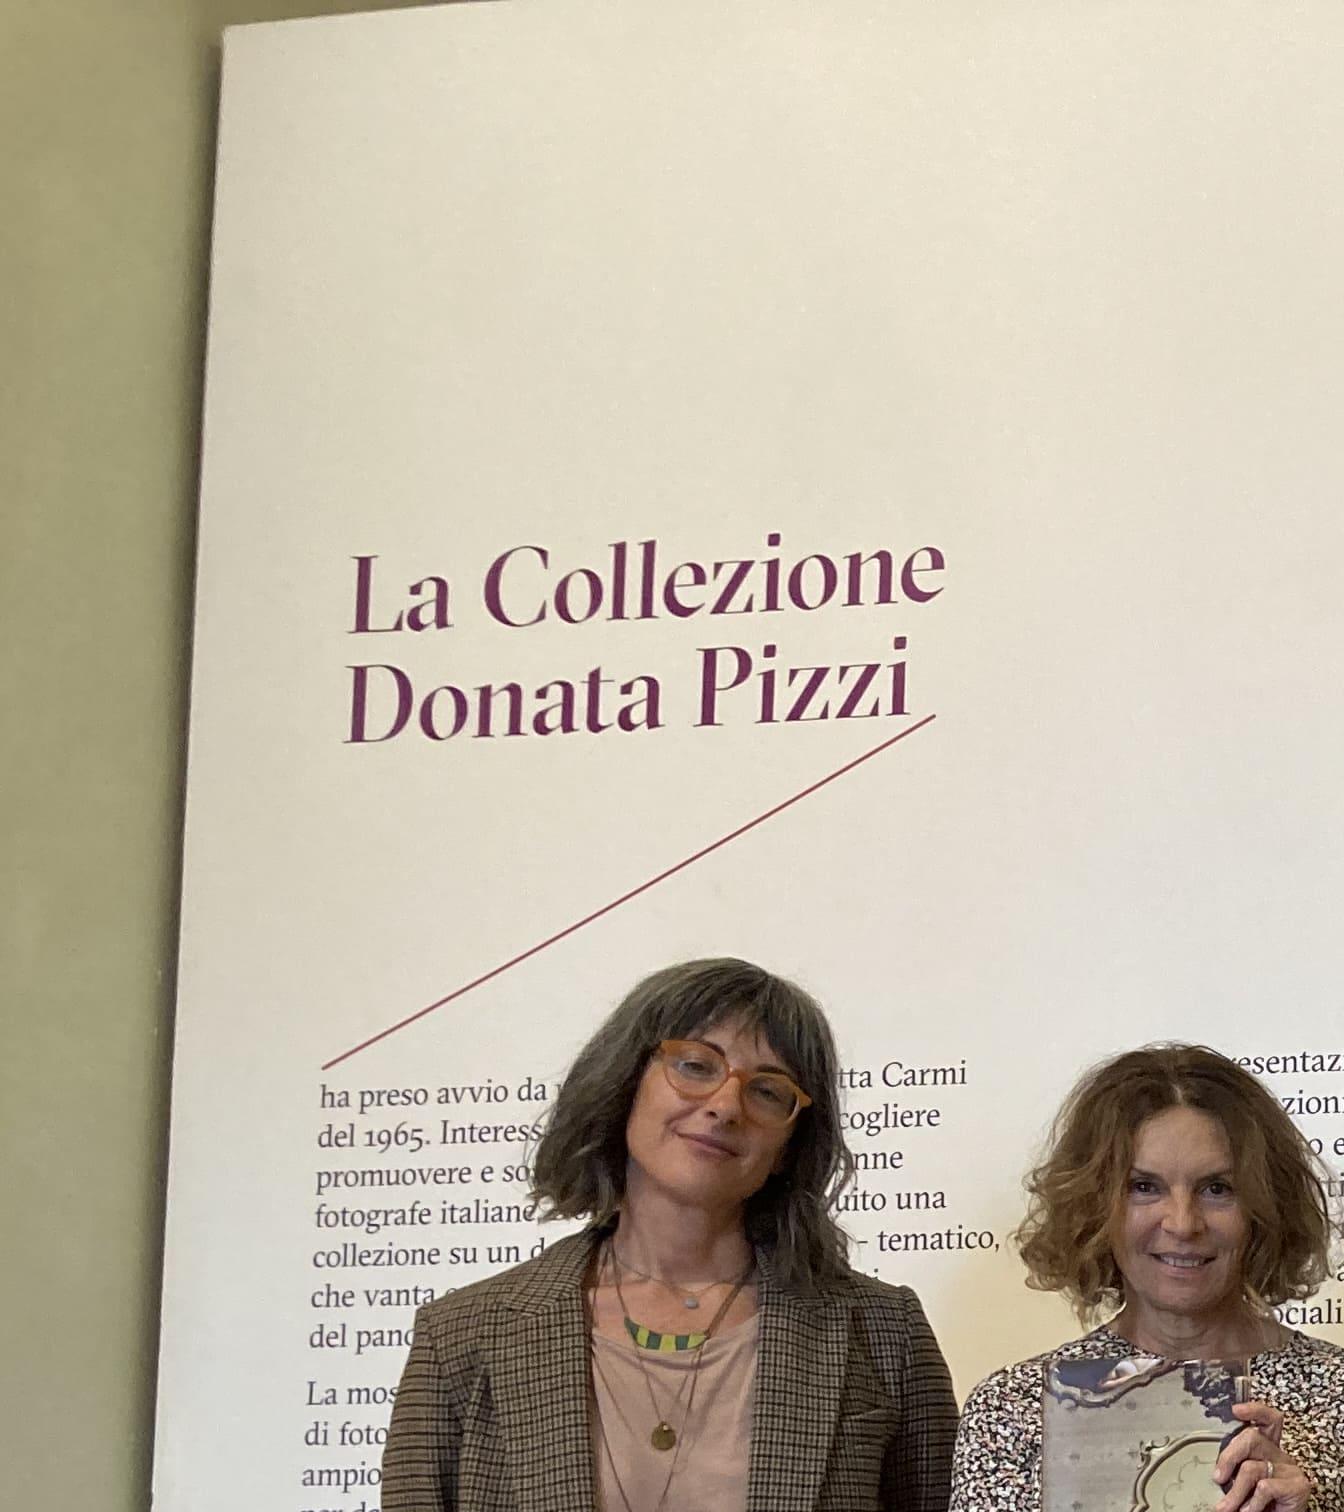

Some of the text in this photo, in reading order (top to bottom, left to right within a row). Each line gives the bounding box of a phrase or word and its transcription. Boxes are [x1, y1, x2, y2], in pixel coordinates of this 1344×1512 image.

[346, 533, 946, 634] La Collezione
[342, 635, 911, 744] Donata Pizzi
[320, 1084, 351, 1109] ha
[359, 1085, 429, 1115] preso
[436, 1079, 508, 1105] avvio
[517, 1077, 547, 1102] da
[882, 1060, 968, 1088] Carmi
[317, 1103, 941, 1153] del 1965. Interess cogliere
[315, 1163, 472, 1195] promuovere
[480, 1165, 494, 1183] e
[315, 1201, 431, 1234] fotografe
[896, 1188, 946, 1211] una
[312, 1240, 440, 1268] collezione
[449, 1245, 478, 1265] su
[487, 1243, 521, 1264] un
[876, 1225, 1000, 1253] tematico,
[311, 1283, 436, 1309] che vanta
[310, 1323, 348, 1348] del
[306, 1381, 337, 1405] La
[304, 1421, 388, 1446] di foto
[301, 1461, 382, 1493] ampio
